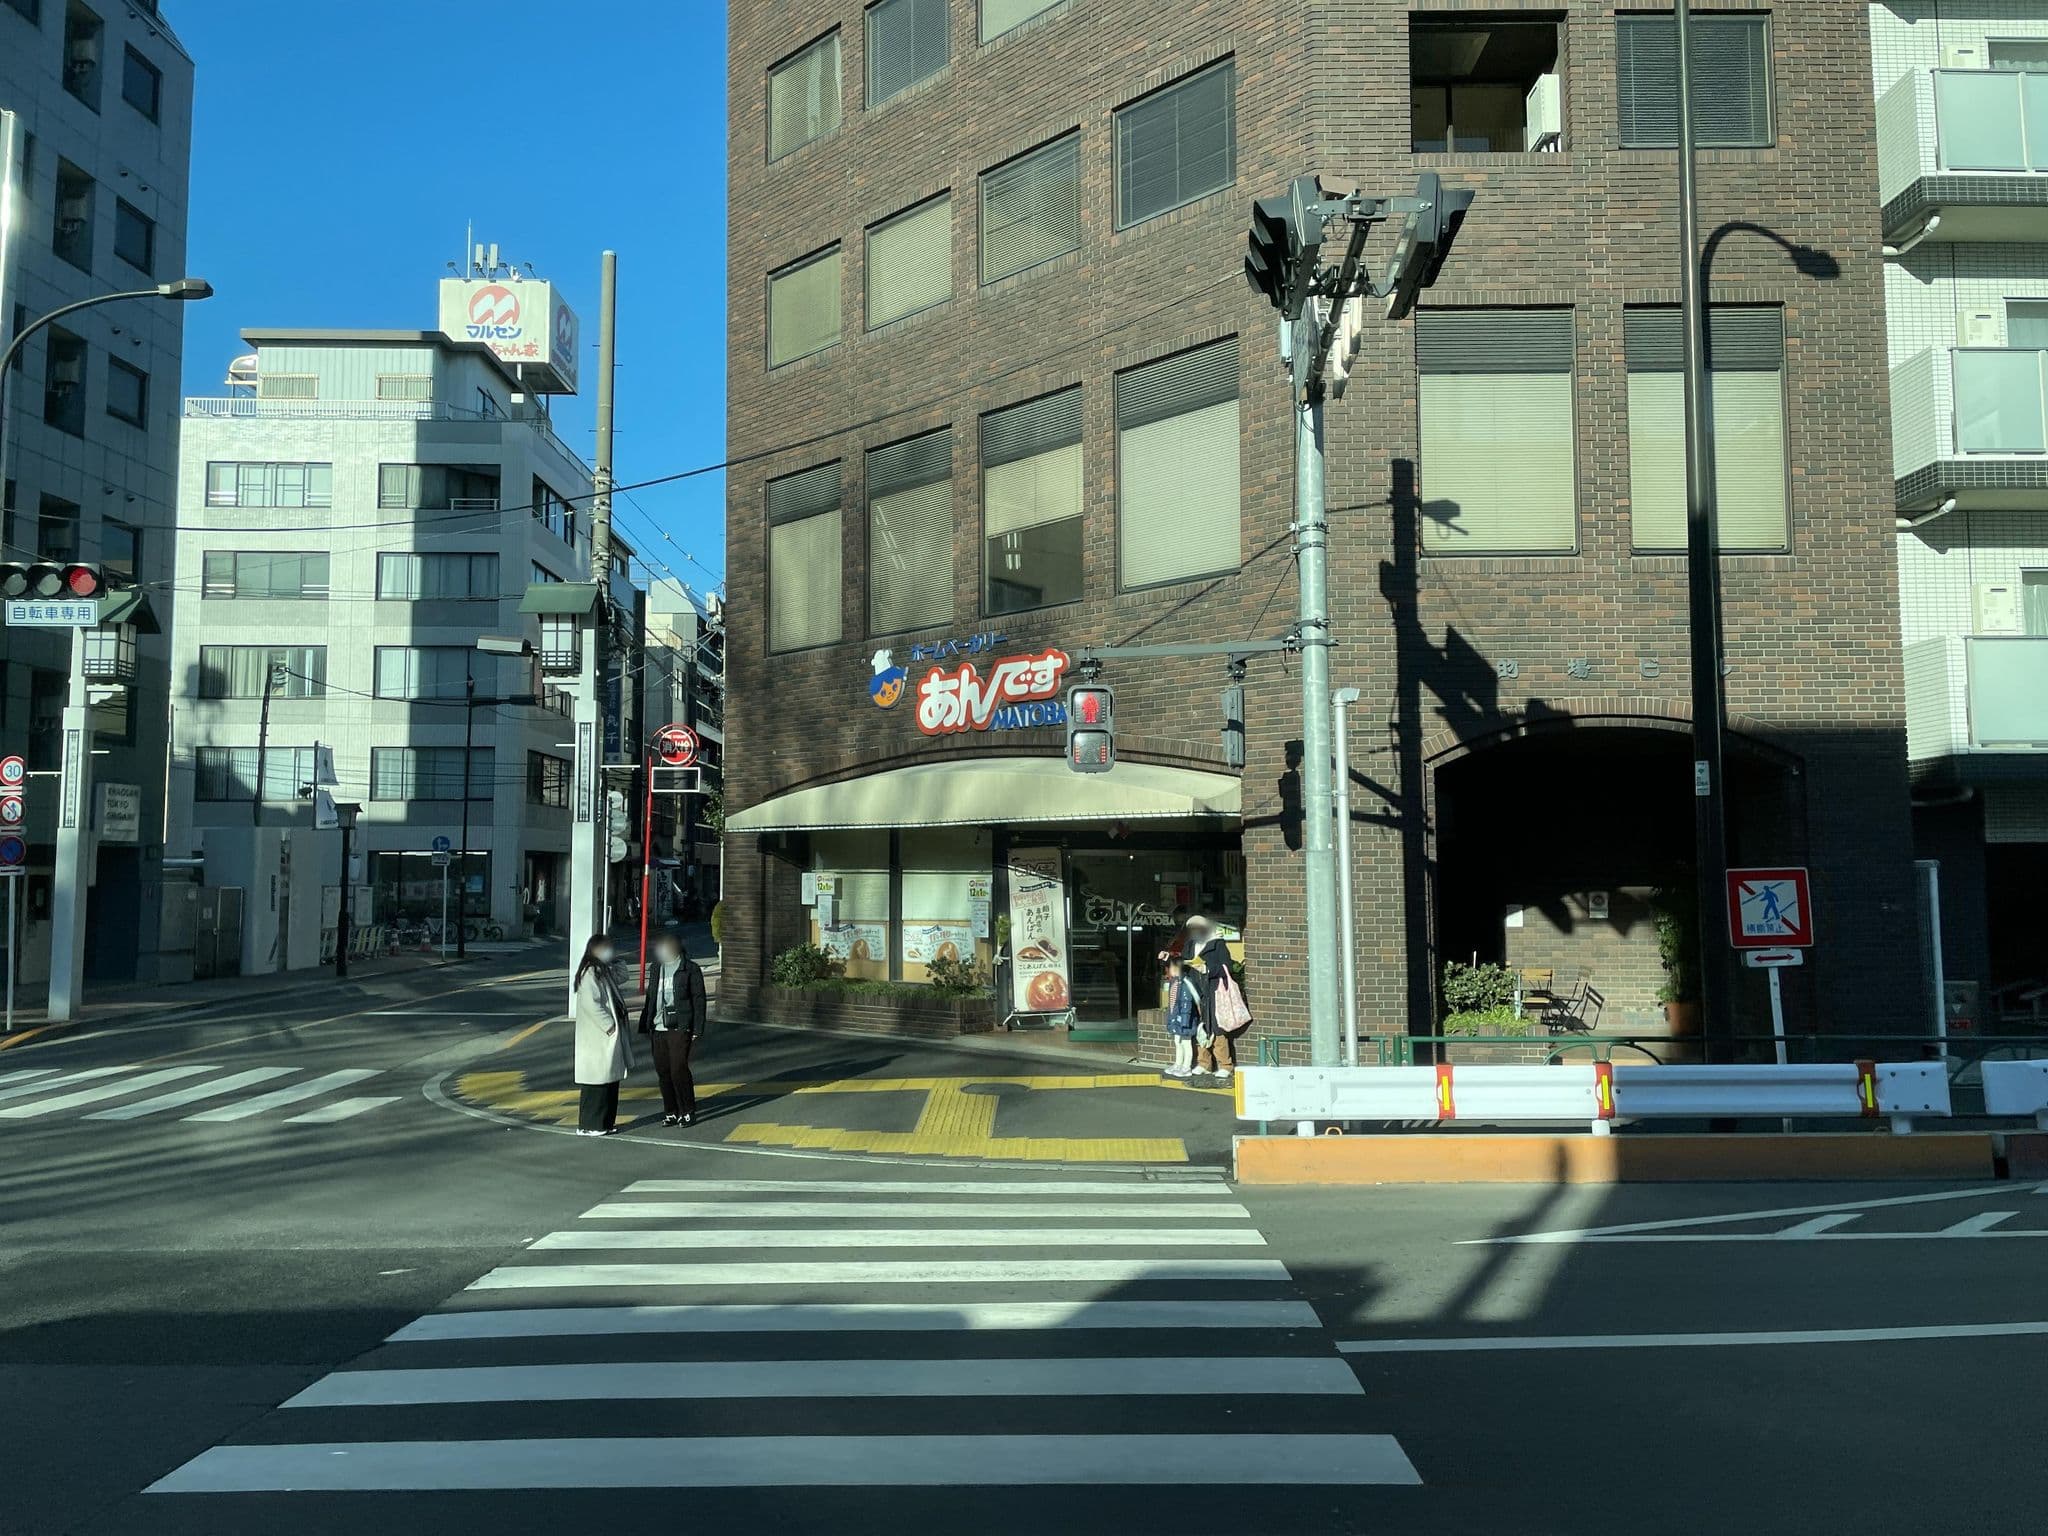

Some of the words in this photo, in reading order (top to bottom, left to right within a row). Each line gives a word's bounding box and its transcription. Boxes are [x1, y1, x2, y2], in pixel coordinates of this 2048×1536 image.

[466, 325, 522, 339] マルセン
[13, 606, 91, 620] 自転車専用
[911, 631, 1008, 662] ホームベーカリー
[918, 652, 1066, 732] あんです
[991, 701, 1067, 731] MATOBA
[5, 765, 21, 777] 30
[1746, 923, 1785, 934] 横断禁止
